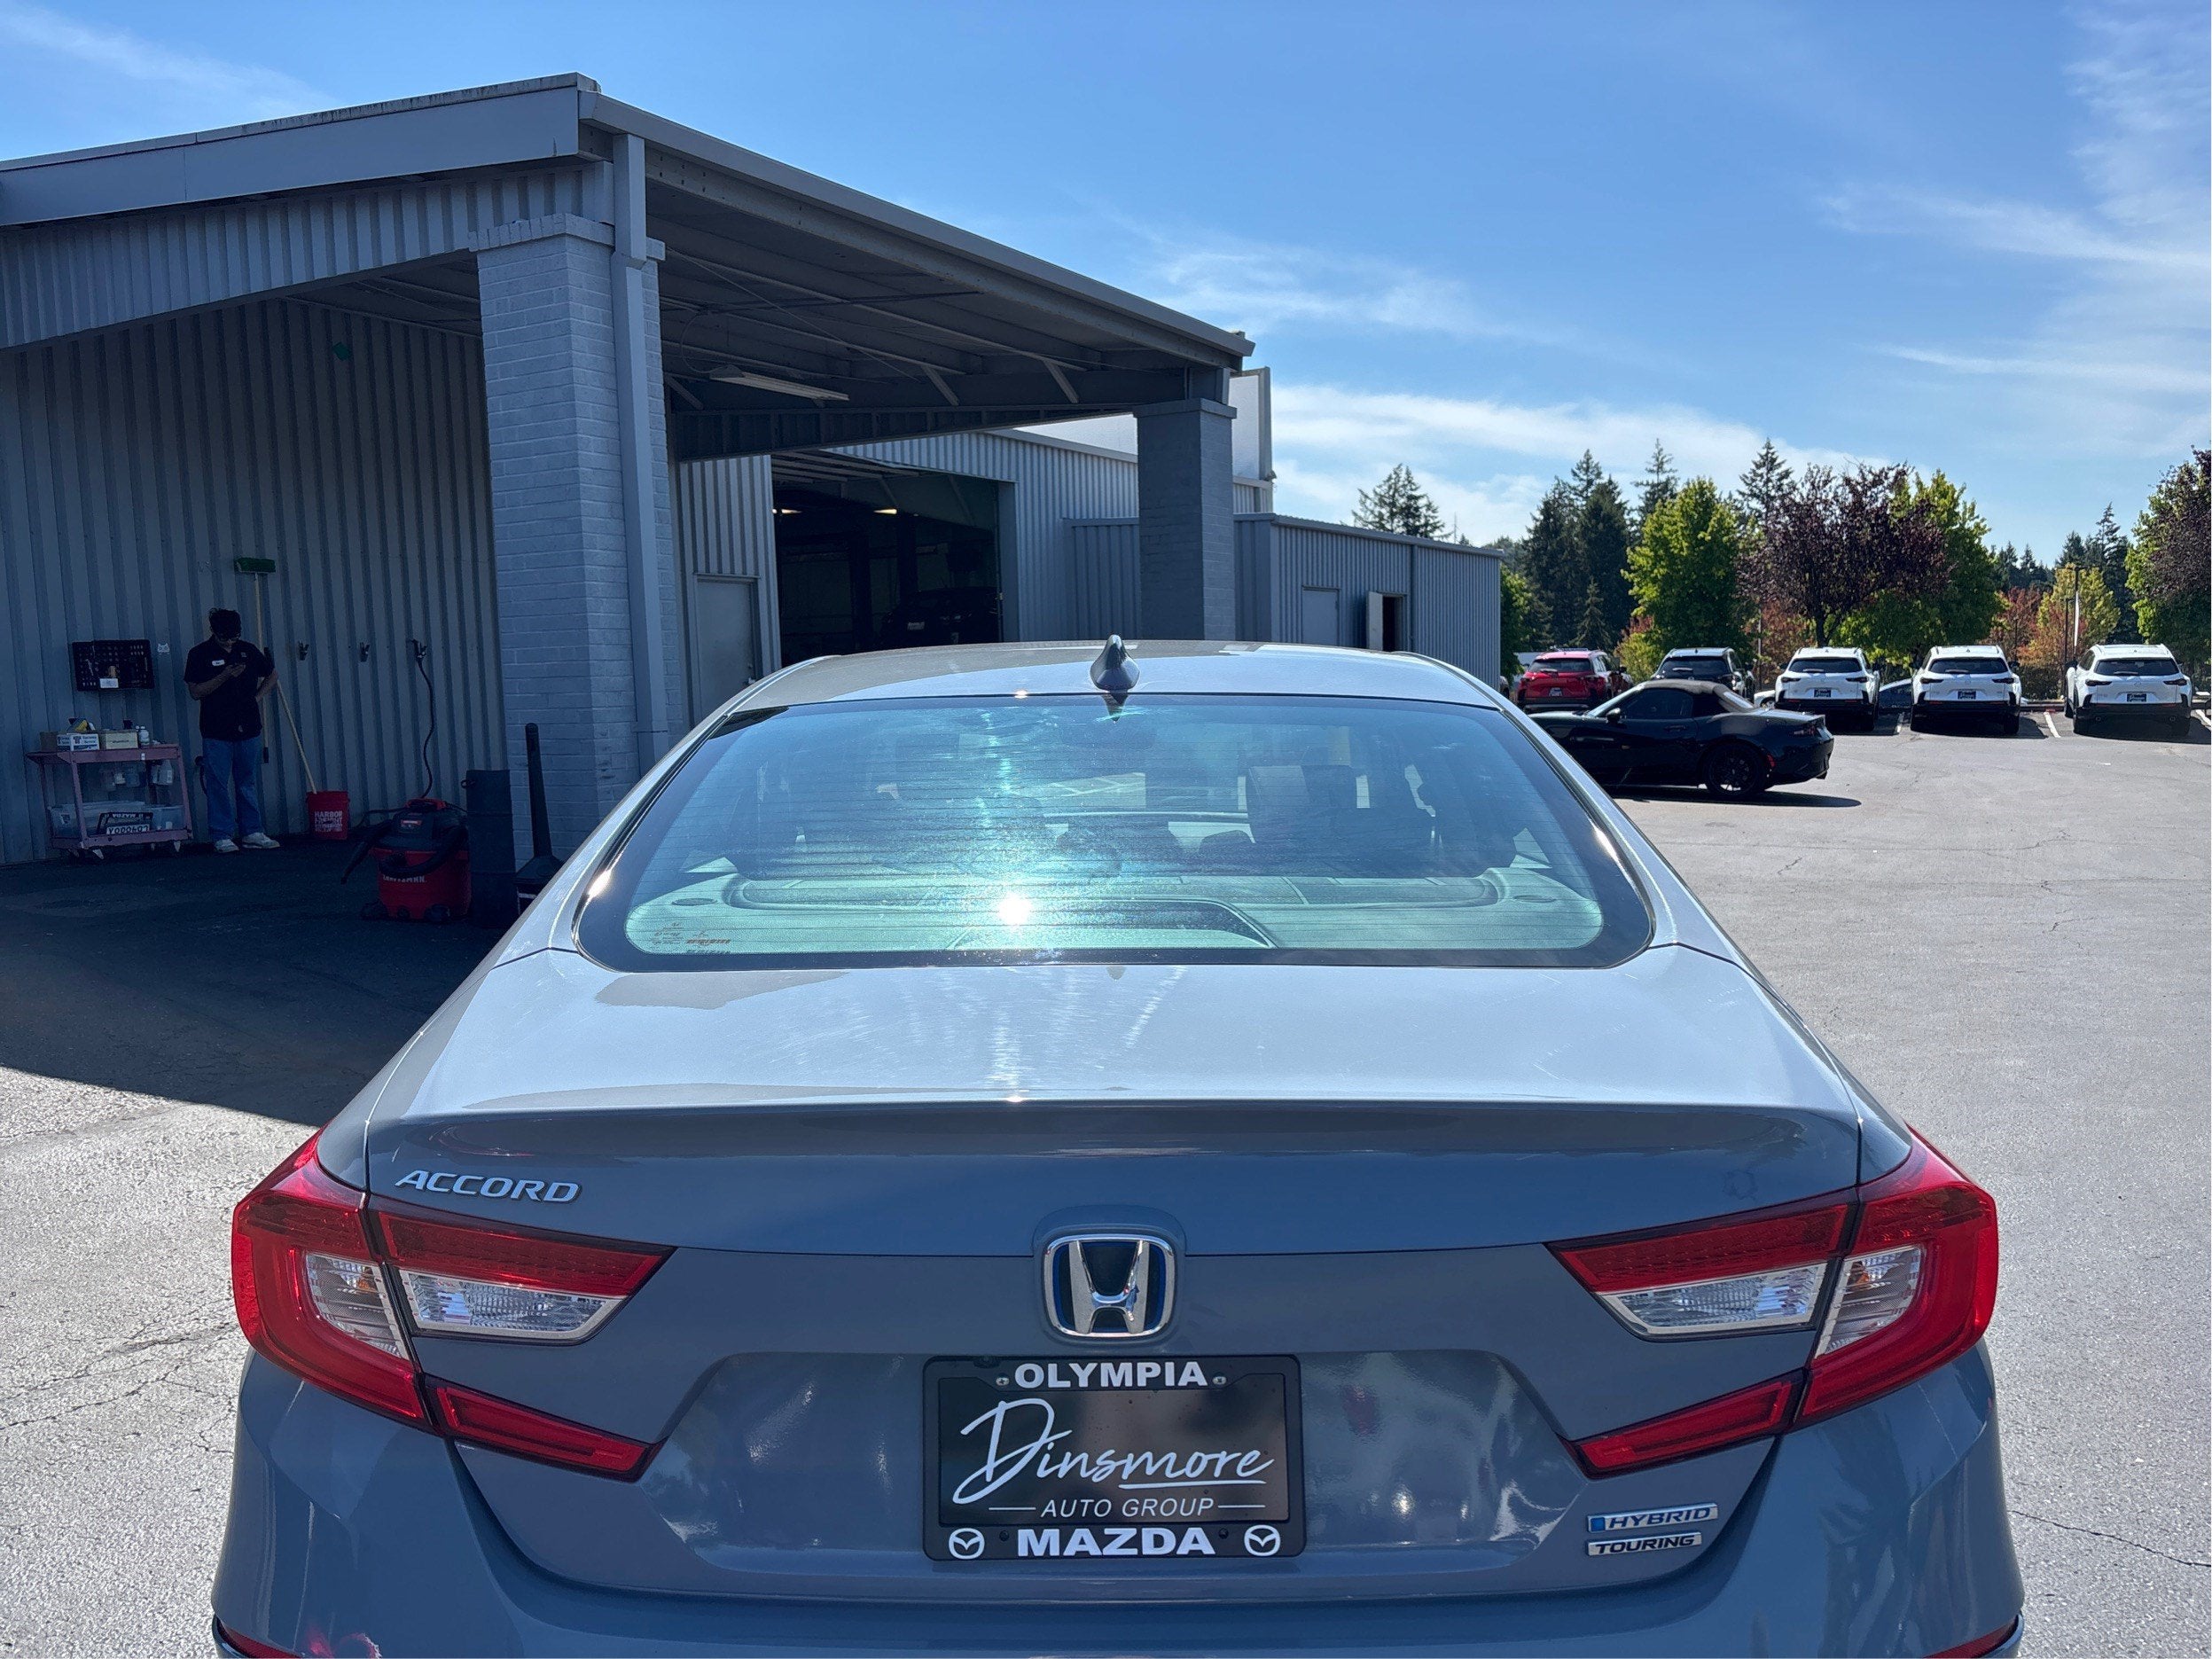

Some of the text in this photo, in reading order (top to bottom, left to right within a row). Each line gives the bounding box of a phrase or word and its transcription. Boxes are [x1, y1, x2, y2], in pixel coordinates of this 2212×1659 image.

[395, 1170, 580, 1202] ACCORD
[1014, 1361, 1208, 1389] OLYMPIA
[952, 1397, 1275, 1505] Dinsmore
[1040, 1497, 1215, 1518] AUTO GROUP
[1608, 1507, 1711, 1529] HYBRID
[1017, 1527, 1215, 1557] MAZDA
[1596, 1535, 1695, 1554] TOURING
